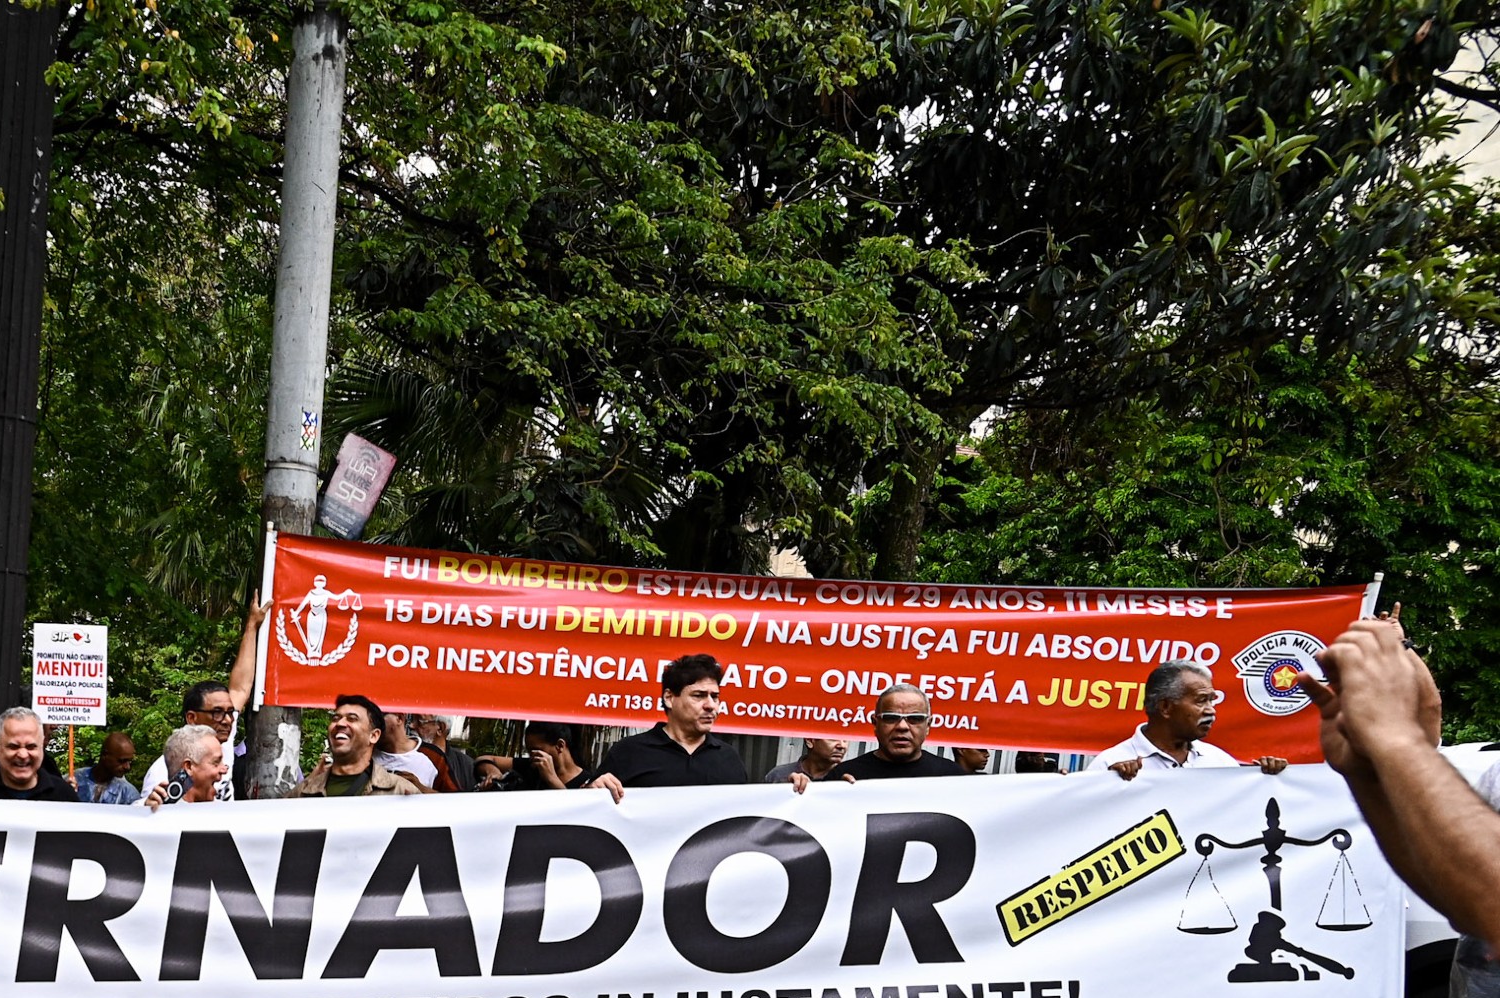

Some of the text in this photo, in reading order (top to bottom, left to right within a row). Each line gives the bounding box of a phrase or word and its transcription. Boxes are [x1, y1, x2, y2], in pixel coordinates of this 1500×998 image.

[334, 481, 367, 503] SP
[343, 470, 372, 493] LIVRE
[383, 556, 1233, 619] FUI BOMBEIRO ESTADUAL, COM 29 ANOS, 11 MESES E
[384, 599, 414, 623] 15
[421, 602, 493, 628] DIAS
[500, 606, 547, 630] FUI
[555, 605, 738, 640] DEMITIDO
[765, 619, 812, 646] NA
[819, 622, 959, 660] JUSTIÇA
[967, 629, 1020, 656] FUI
[1024, 633, 1221, 666] ABSOLVIDO
[37, 652, 65, 660] PROMETEU
[1241, 636, 1287, 666] POLICIA
[36, 661, 104, 677] MENTIU!
[367, 643, 429, 669] POR
[436, 646, 649, 682] INEXISTÊNCIA
[719, 663, 788, 690] ATO
[918, 670, 998, 702] ESTÁ
[1005, 680, 1029, 705] A
[35, 680, 77, 688] VALORIZAÇÃO
[585, 693, 622, 709] ART
[625, 695, 653, 710] 136
[1012, 827, 1168, 922] RESPEITO
